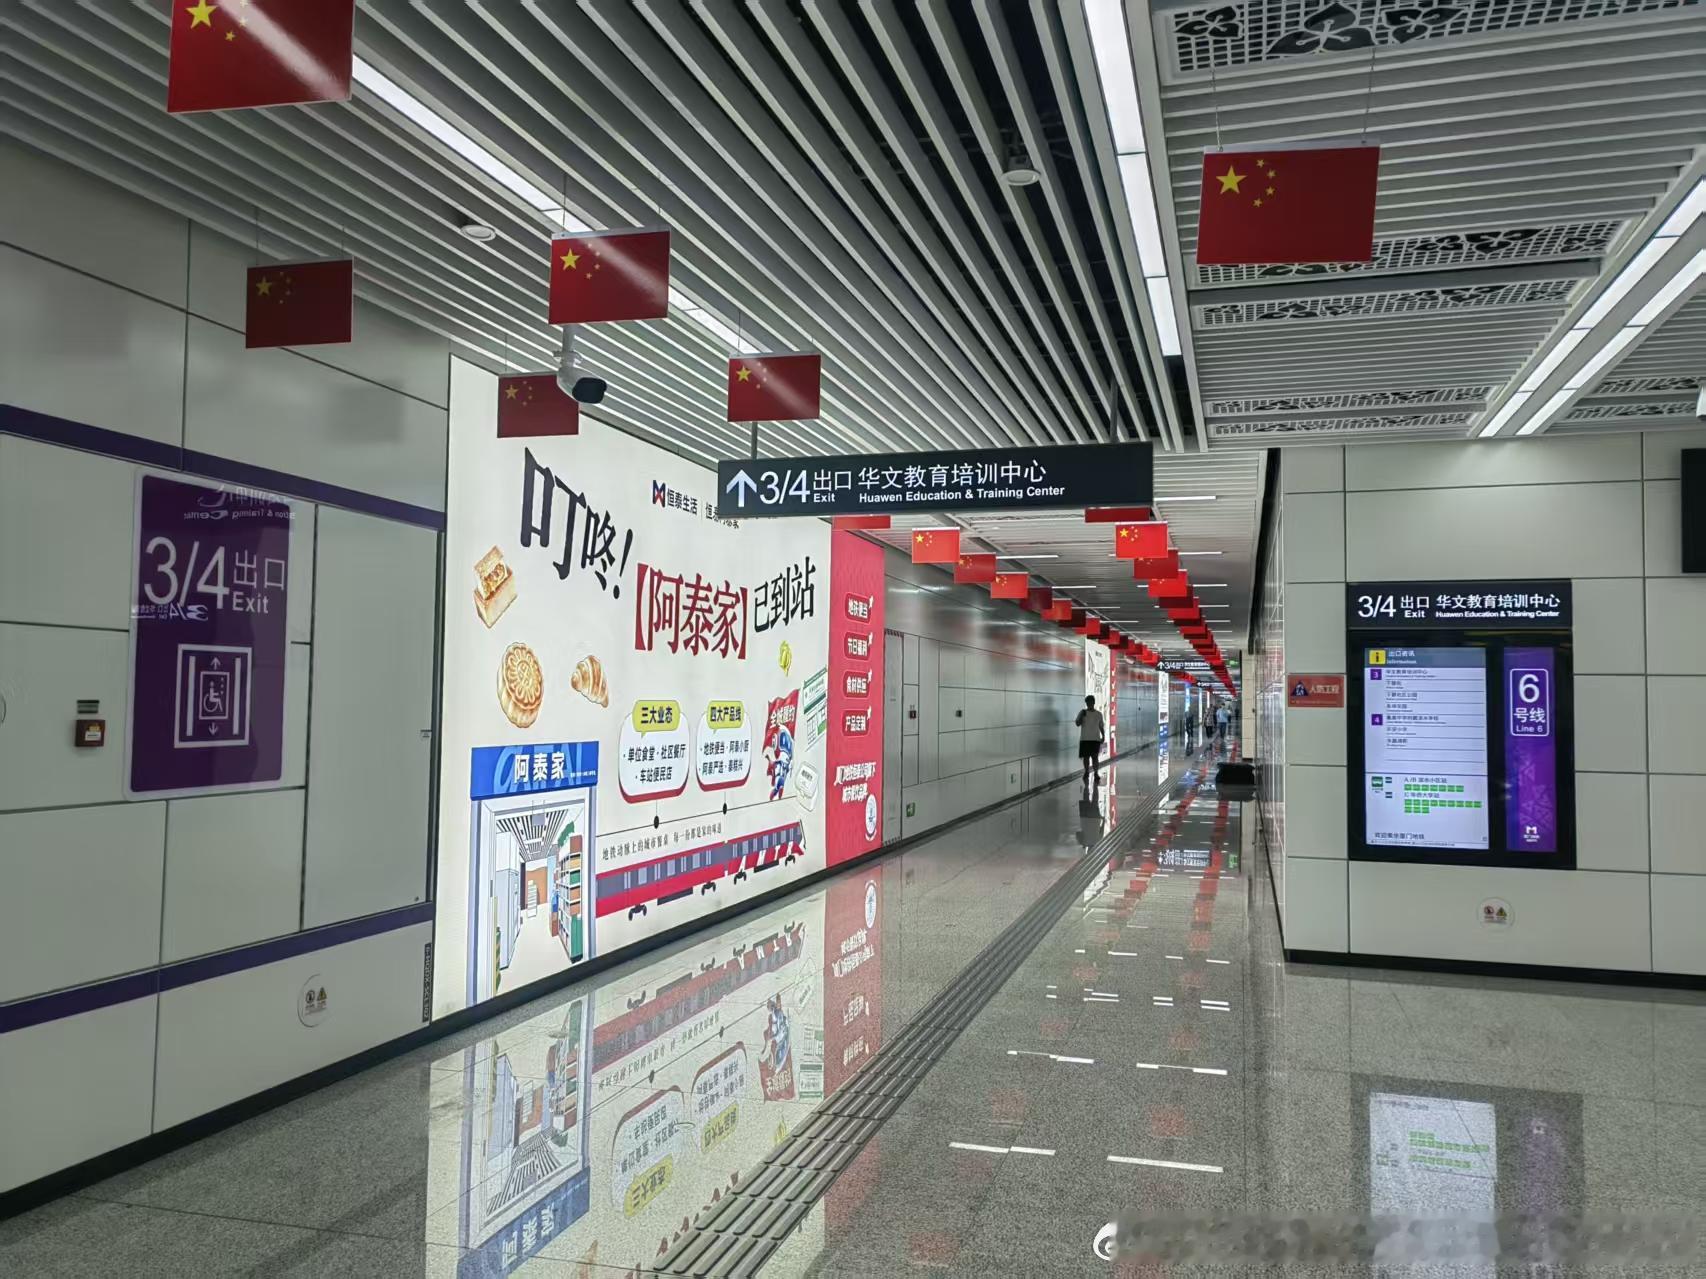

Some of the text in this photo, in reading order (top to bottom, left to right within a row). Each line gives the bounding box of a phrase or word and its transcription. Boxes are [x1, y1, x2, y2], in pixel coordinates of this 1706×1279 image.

[759, 459, 1047, 505] 3/4 出口 华文教育培训中心
[667, 488, 698, 516] 恒泰生活
[813, 484, 1066, 504] Exit Huawen Education & Training Center
[144, 536, 285, 610] 3/4 出口
[232, 592, 269, 614] Exit
[754, 555, 817, 634] 已到站
[1358, 593, 1561, 618] 3/4 出口 华文教育培训中心
[1404, 609, 1426, 618] Exit
[1435, 610, 1463, 618] Huawen
[1464, 610, 1499, 618] Education
[1507, 609, 1535, 619] Training
[1535, 609, 1560, 617] Center
[1518, 673, 1540, 703] 6
[641, 706, 673, 724] 三大业态
[709, 704, 742, 722] 四大产品线
[1514, 708, 1546, 723] 号线
[1516, 725, 1535, 733] Line
[627, 744, 686, 761] 单位食堂 社区餐厅
[703, 741, 725, 756] 地铁便当
[513, 751, 565, 783] 阿泰家
[639, 766, 673, 783] 车站便民店
